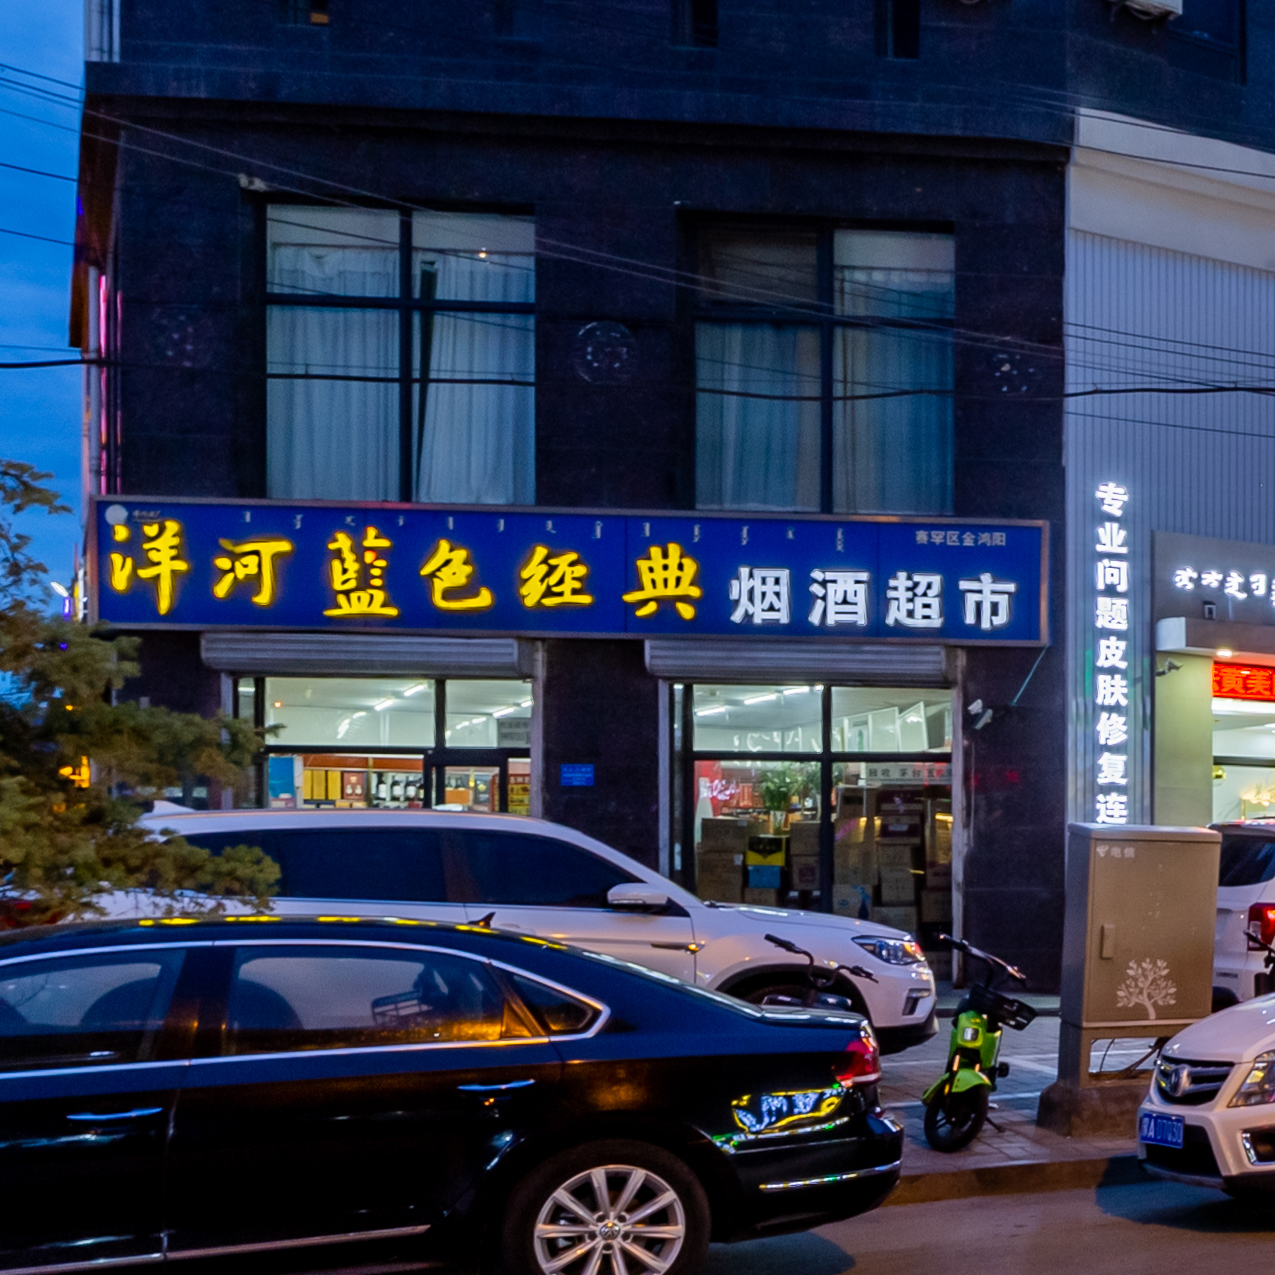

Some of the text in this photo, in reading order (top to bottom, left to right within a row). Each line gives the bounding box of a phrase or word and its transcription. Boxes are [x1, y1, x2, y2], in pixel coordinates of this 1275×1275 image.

[915, 530, 1006, 547] 赛罕区金鸿阳
[729, 565, 1018, 631] 烟酒超市
[1095, 482, 1129, 823] 专业问题皮肤修复连
